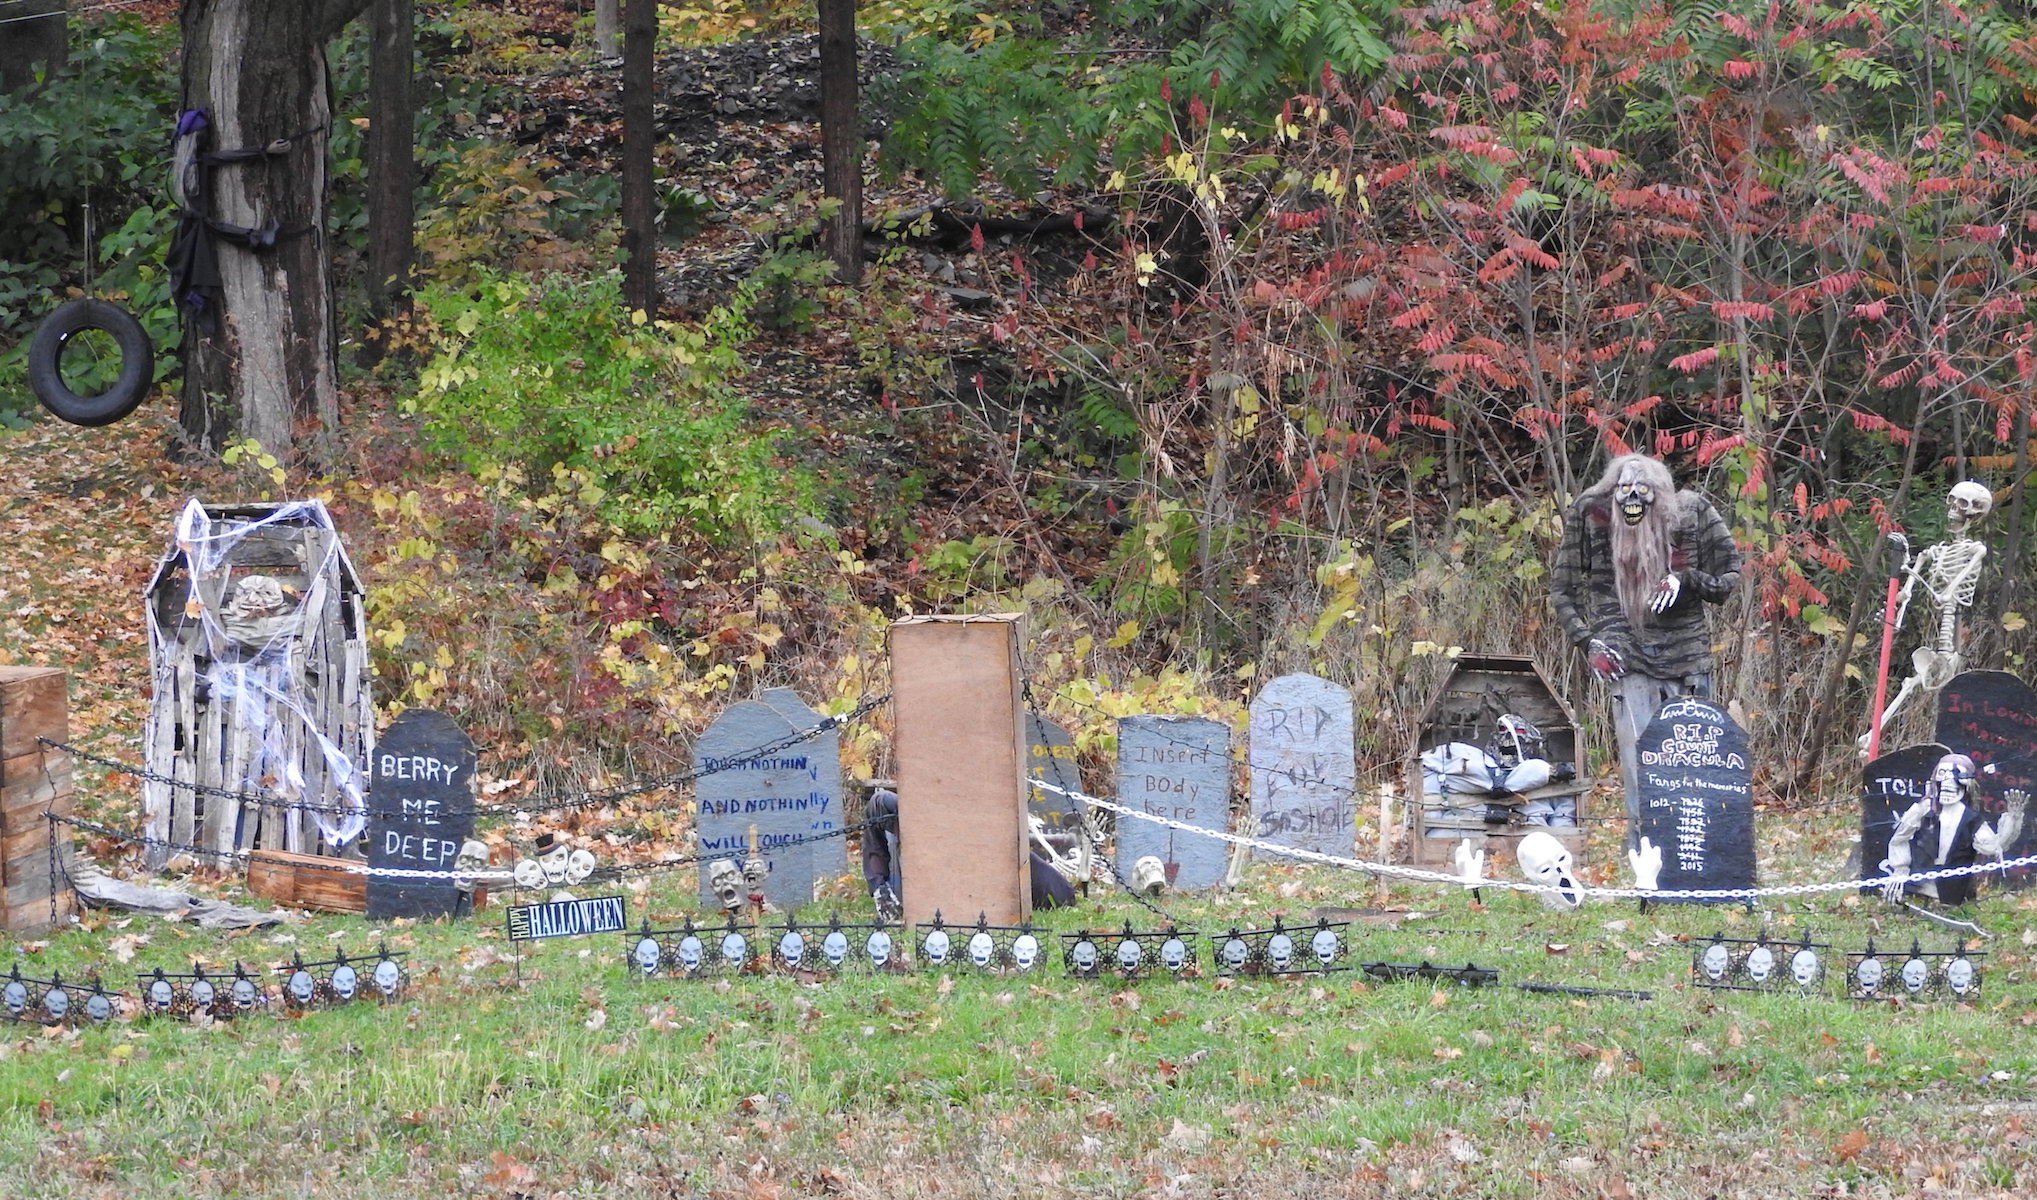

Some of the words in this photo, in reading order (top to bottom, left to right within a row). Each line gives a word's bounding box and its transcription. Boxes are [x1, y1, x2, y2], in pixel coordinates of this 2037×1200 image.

[1662, 738, 1718, 754] COUNT
[381, 754, 459, 786] BERRY
[1642, 751, 1745, 770] DRACULA
[402, 798, 441, 824] ME
[702, 799, 740, 815] AND
[1649, 798, 1670, 808] 1012
[385, 830, 457, 867] DEEP
[702, 836, 749, 850] WILL
[1680, 861, 1703, 871] 2015
[509, 907, 530, 939] HAPPY
[528, 897, 624, 938] HALLOWEEN
